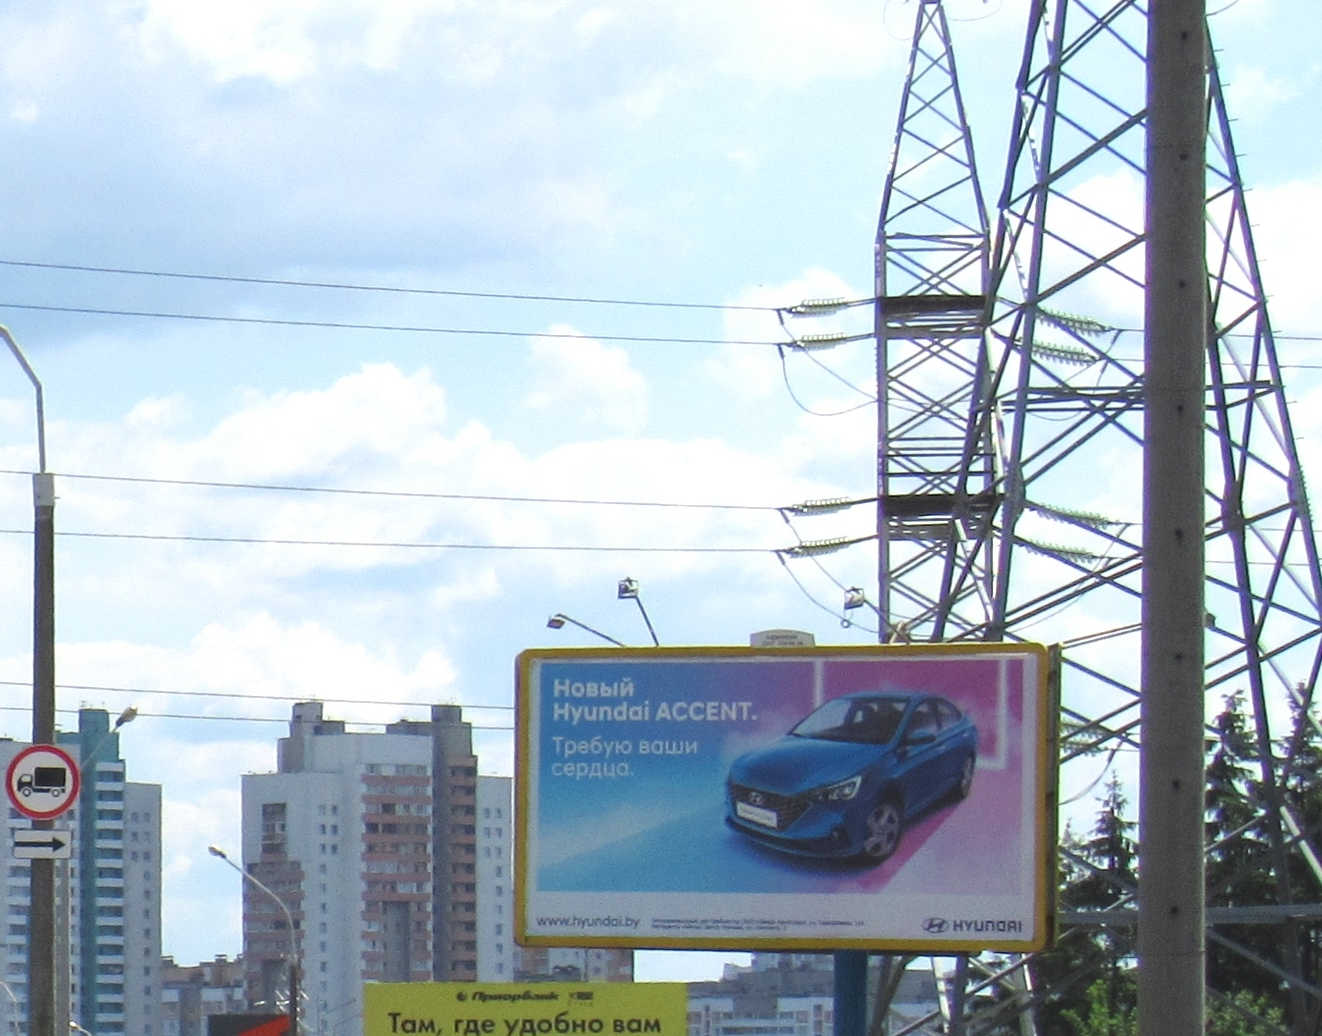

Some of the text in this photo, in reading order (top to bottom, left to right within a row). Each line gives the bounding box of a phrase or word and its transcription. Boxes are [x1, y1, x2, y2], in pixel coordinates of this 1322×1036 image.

[553, 677, 635, 698] Новый
[553, 701, 757, 726] Hyundai ACCENT.
[552, 736, 698, 758] Требую ваши
[552, 762, 634, 779] сердца.
[536, 915, 641, 929] www.hyundai.by
[953, 919, 1022, 932] HYUNDAI
[472, 990, 560, 1003] Приорбанк
[388, 1012, 442, 1036] Там,
[454, 1018, 496, 1036] где
[613, 1018, 661, 1033] вам
